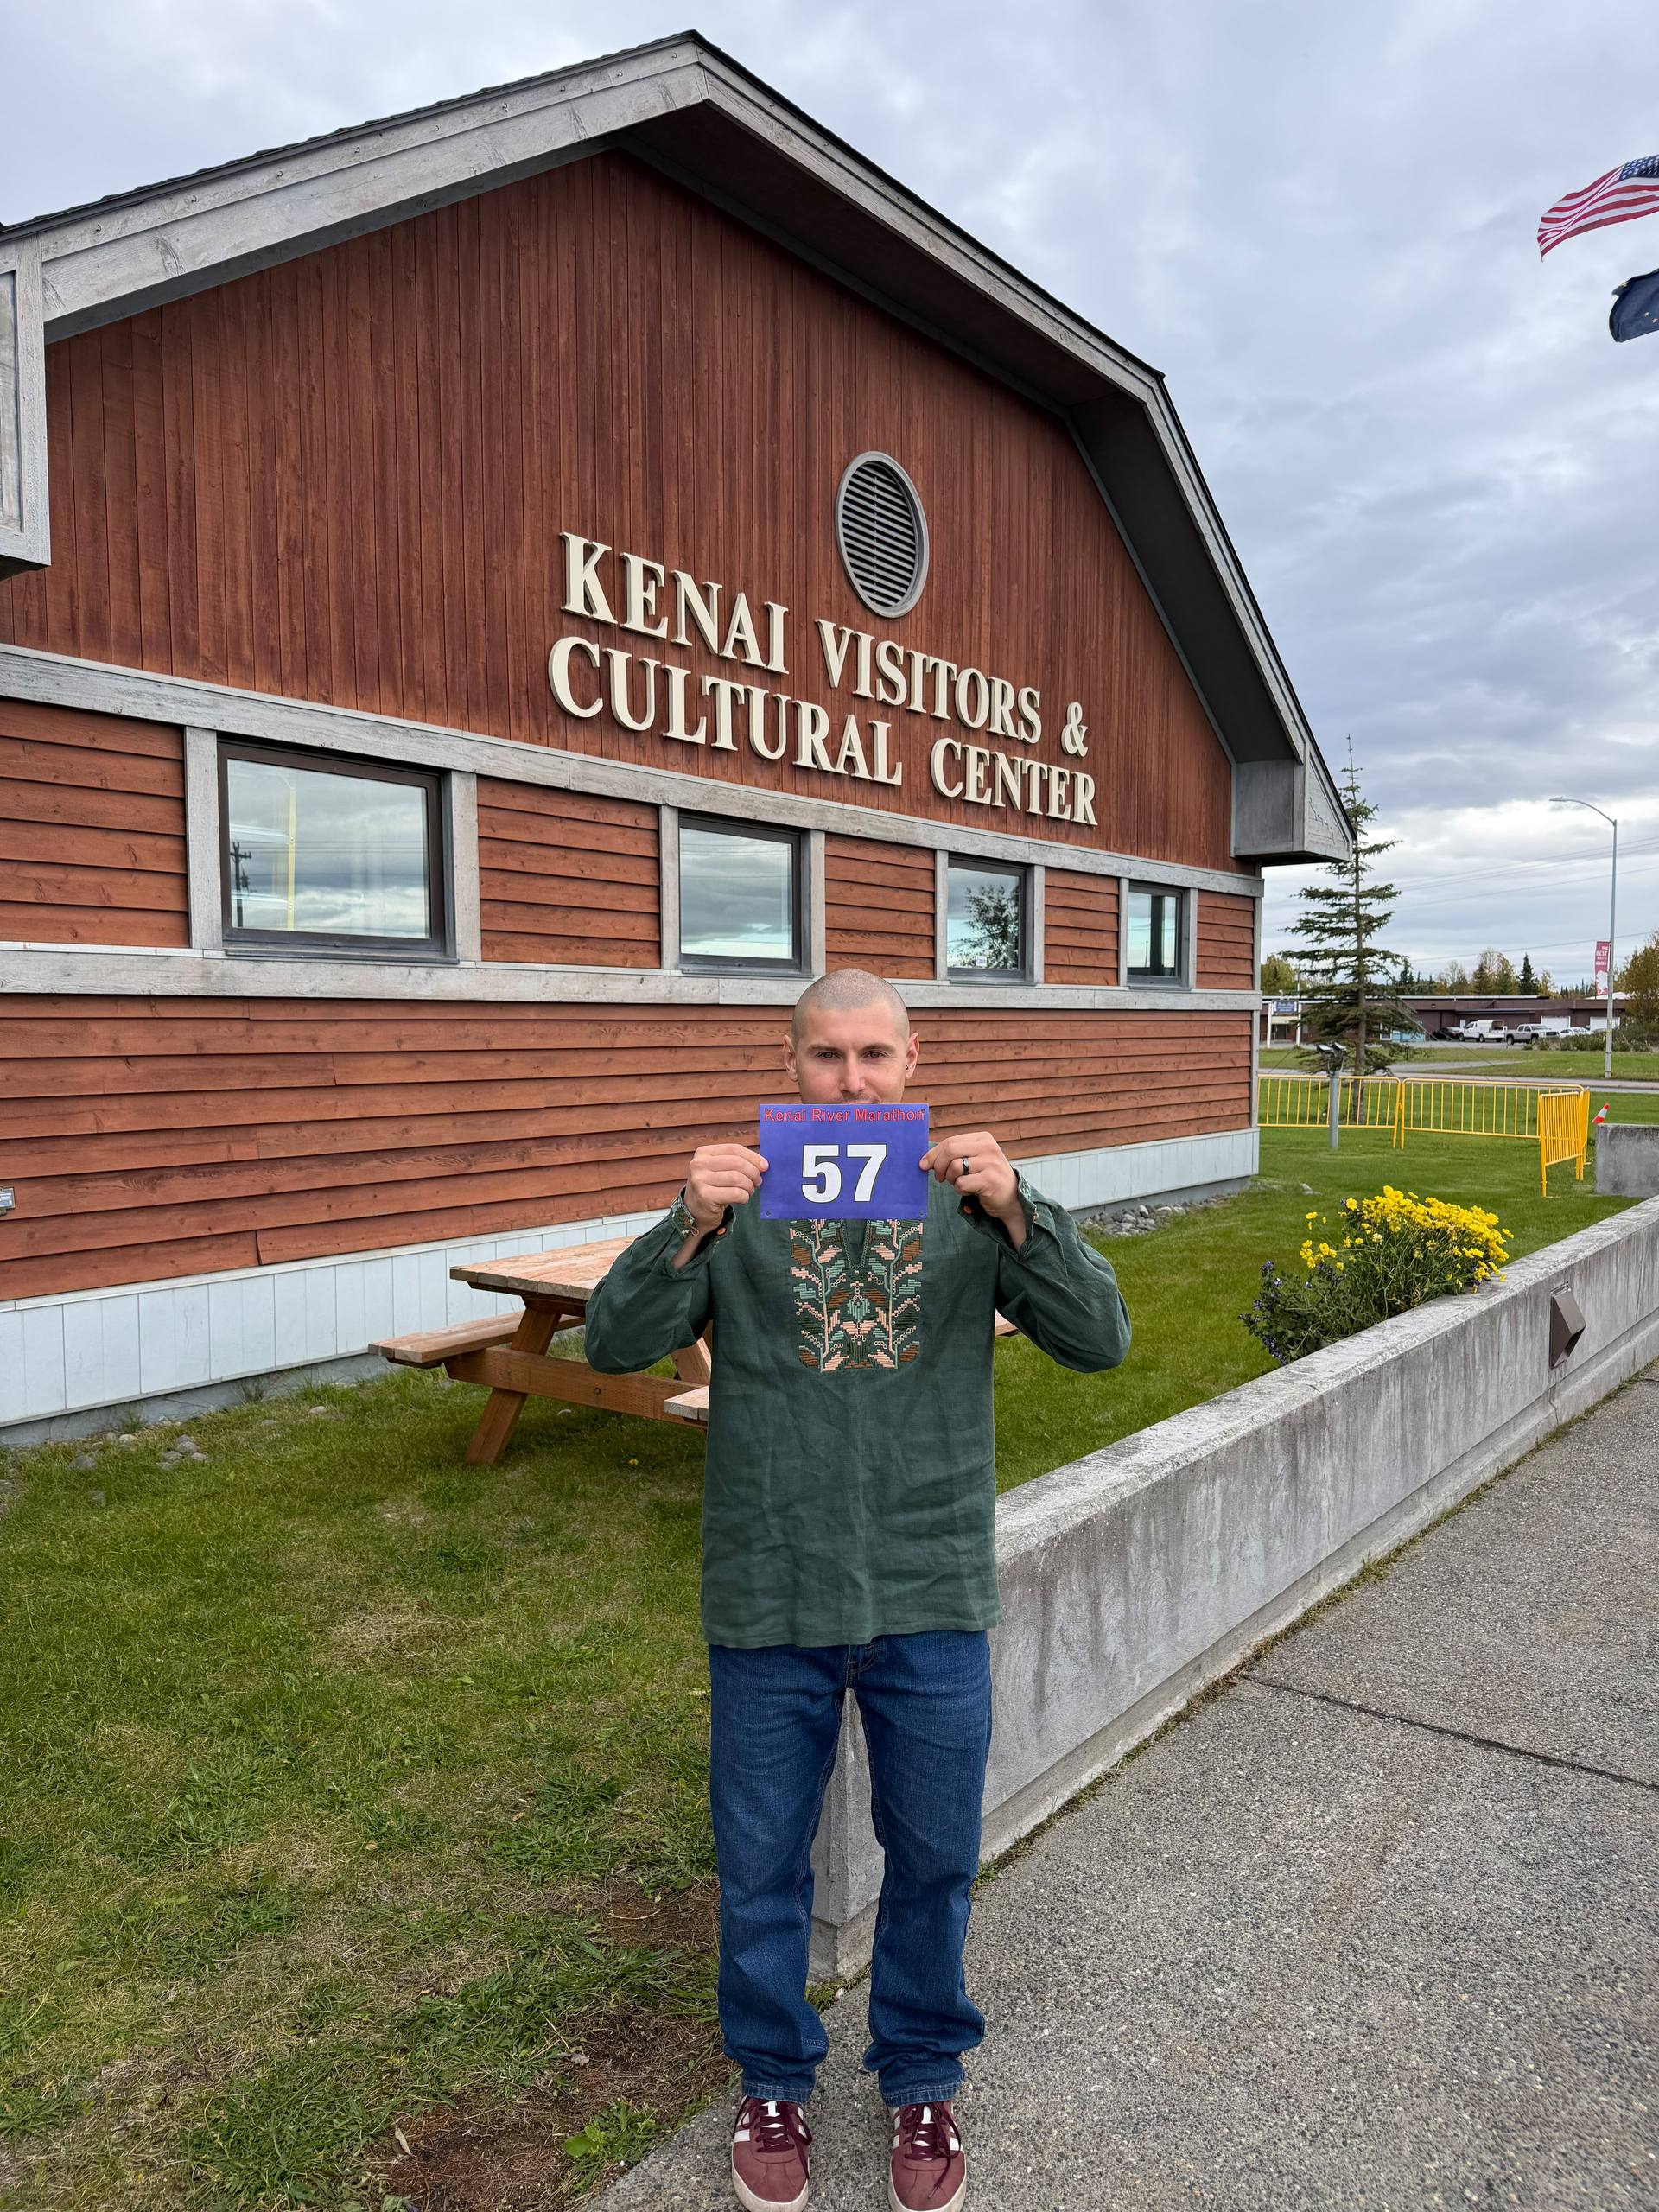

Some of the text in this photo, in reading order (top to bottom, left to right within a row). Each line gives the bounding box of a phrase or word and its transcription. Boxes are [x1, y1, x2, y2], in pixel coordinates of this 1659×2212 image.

[561, 531, 1089, 758] KENAI VISITORS &
[549, 636, 1098, 826] CULTURAL CENTER
[764, 1108, 925, 1122] Kenai River Marathon
[801, 1143, 887, 1204] 57
